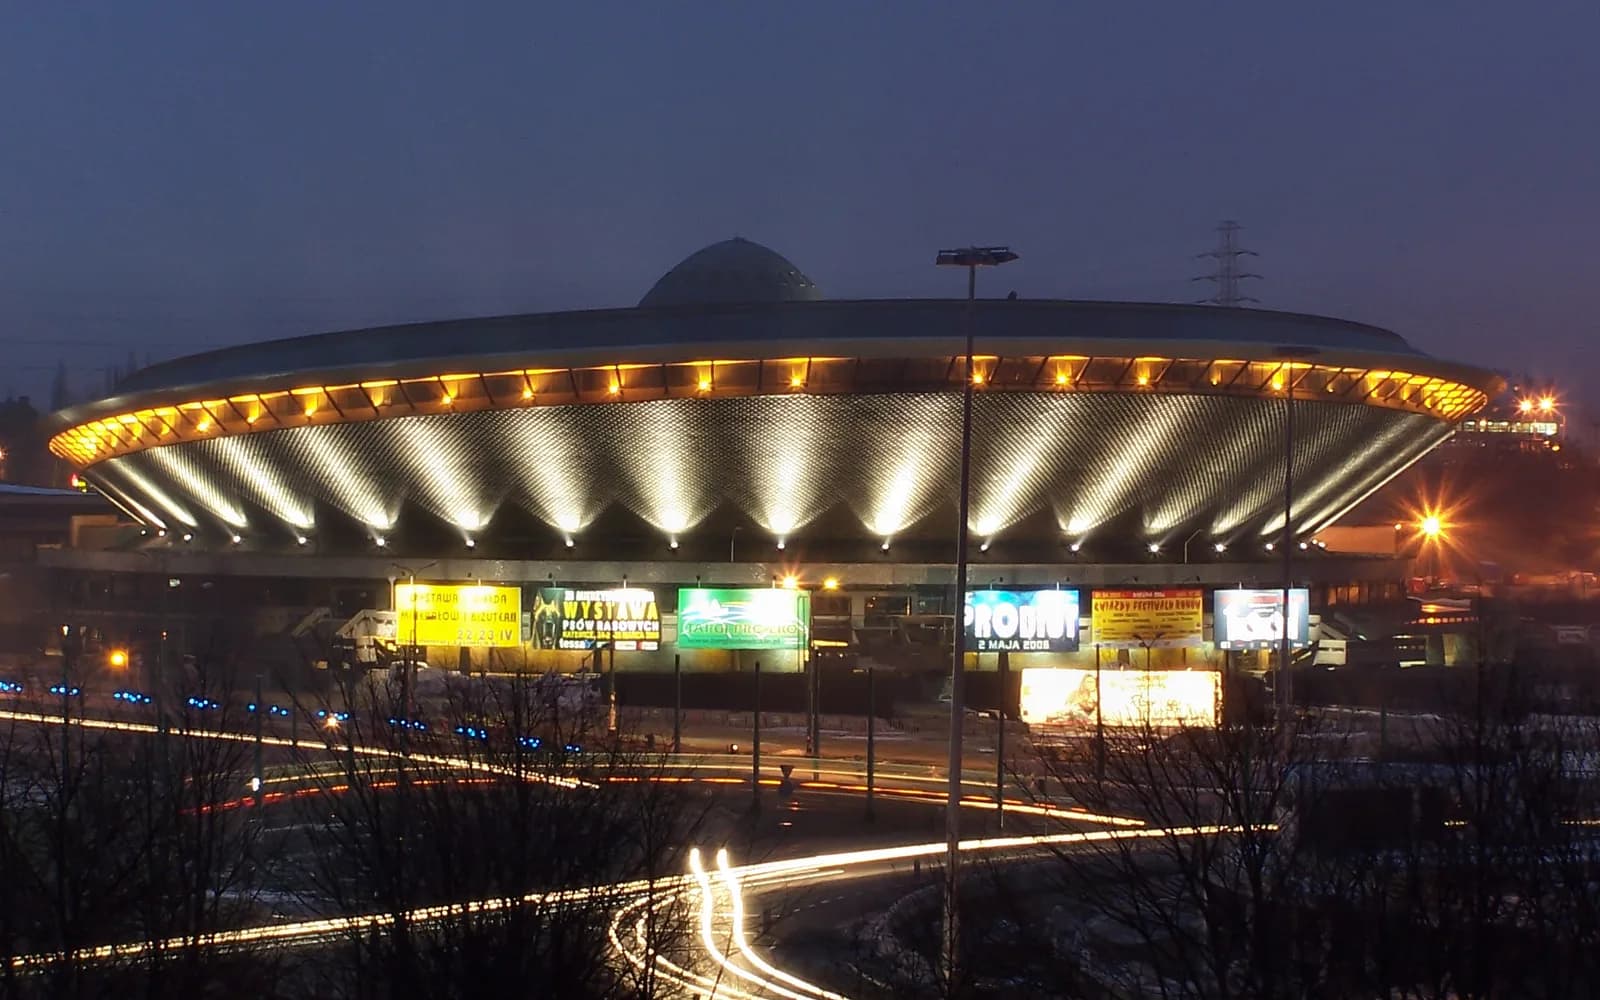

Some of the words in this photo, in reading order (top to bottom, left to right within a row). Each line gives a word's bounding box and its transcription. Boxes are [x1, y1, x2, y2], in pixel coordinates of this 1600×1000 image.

[563, 601, 658, 620] WYSTAWA
[562, 619, 595, 631] PSÓW
[596, 620, 659, 631] RASOWYCH
[500, 629, 512, 641] IV
[978, 640, 986, 649] 2
[988, 640, 1020, 649] MAJA
[1023, 640, 1050, 650] 2008
